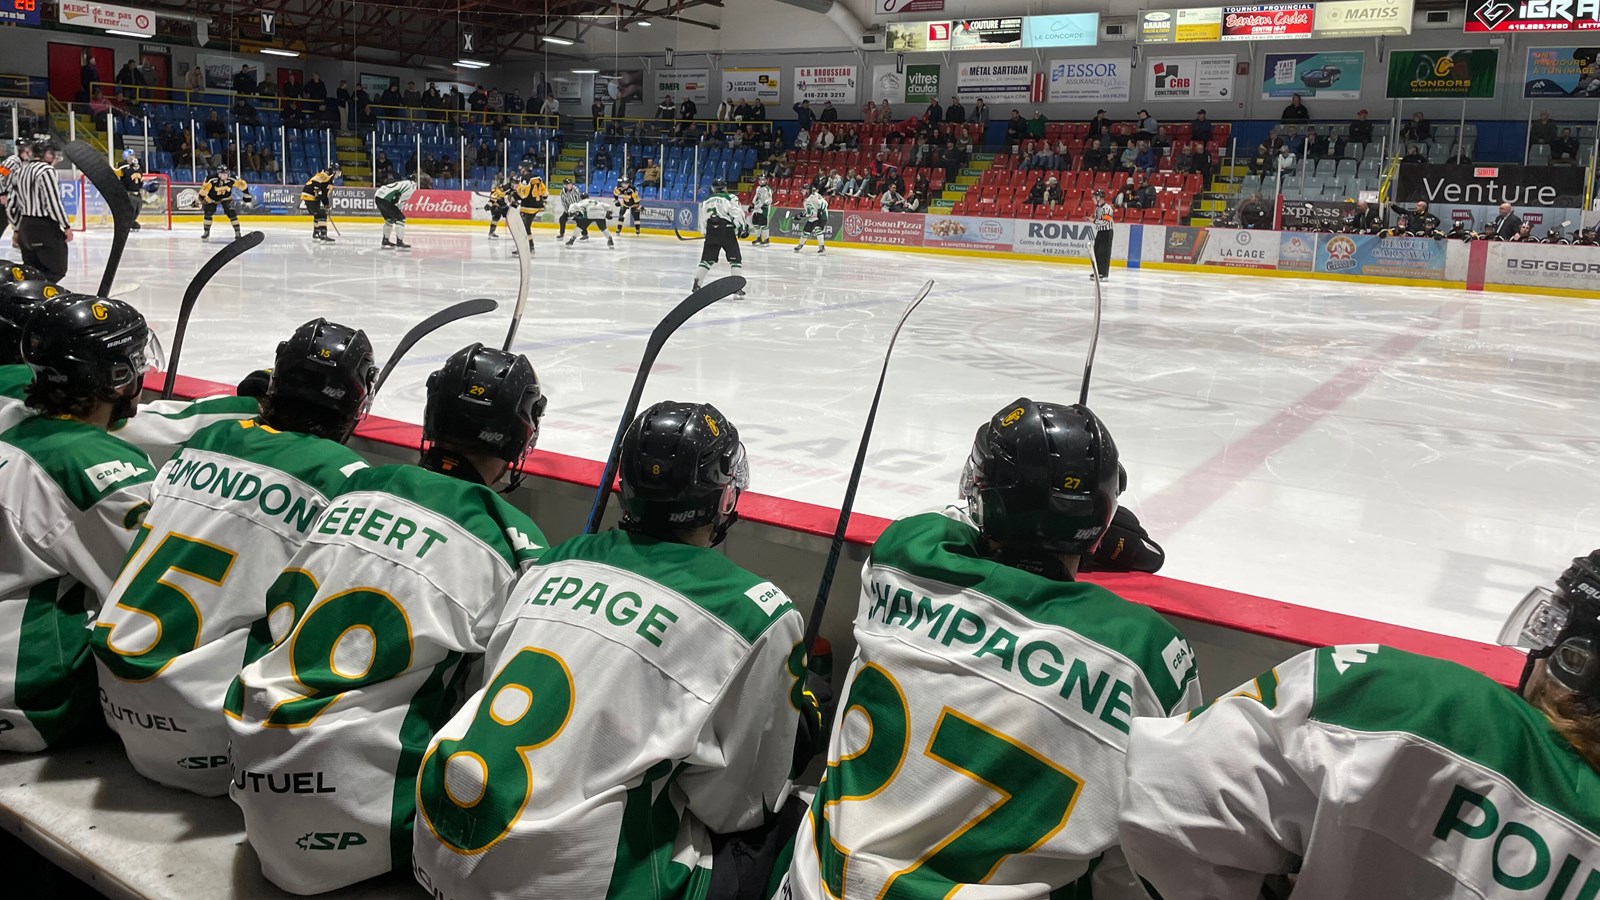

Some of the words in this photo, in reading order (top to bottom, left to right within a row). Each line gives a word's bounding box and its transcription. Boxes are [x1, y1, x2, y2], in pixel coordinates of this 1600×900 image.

[92, 7, 102, 15] de
[118, 12, 132, 20] pas
[1226, 13, 1273, 27] Bantam
[1273, 11, 1309, 26] Cadet
[1345, 7, 1399, 20] MATISS
[262, 14, 274, 32] Y
[970, 20, 999, 30] COUTURE
[465, 34, 473, 50] X
[813, 68, 851, 77] BROUSSEAU
[969, 65, 991, 76] MÉTAL
[992, 64, 1029, 75] SARTIGAN
[1067, 63, 1117, 77] ESSOR
[908, 73, 938, 85] vitres
[1170, 78, 1190, 88] CRB
[1410, 80, 1471, 88] CONDORS
[660, 83, 680, 91] BMR
[907, 84, 938, 93] d'autos
[263, 191, 295, 204] MARQUE
[332, 190, 366, 198] MEUBLES
[1423, 177, 1557, 205] Venture
[416, 195, 469, 214] Hortons
[1028, 222, 1095, 241] RONA
[1380, 239, 1429, 250] BEAUCE
[1220, 249, 1233, 257] LA
[1236, 249, 1266, 259] CAGE
[1372, 247, 1434, 260] CARNAVAL
[319, 349, 331, 358] 15
[470, 384, 486, 396] 29
[96, 466, 122, 481] CBA
[652, 464, 661, 475] 8
[1064, 477, 1081, 489] 27
[314, 500, 449, 559] ÉBERT
[758, 588, 779, 603] CBA
[526, 576, 679, 648] EPAGE
[1171, 648, 1188, 671] CBA
[416, 645, 576, 856] 8
[812, 660, 1086, 900] 27
[308, 831, 368, 851] SP
